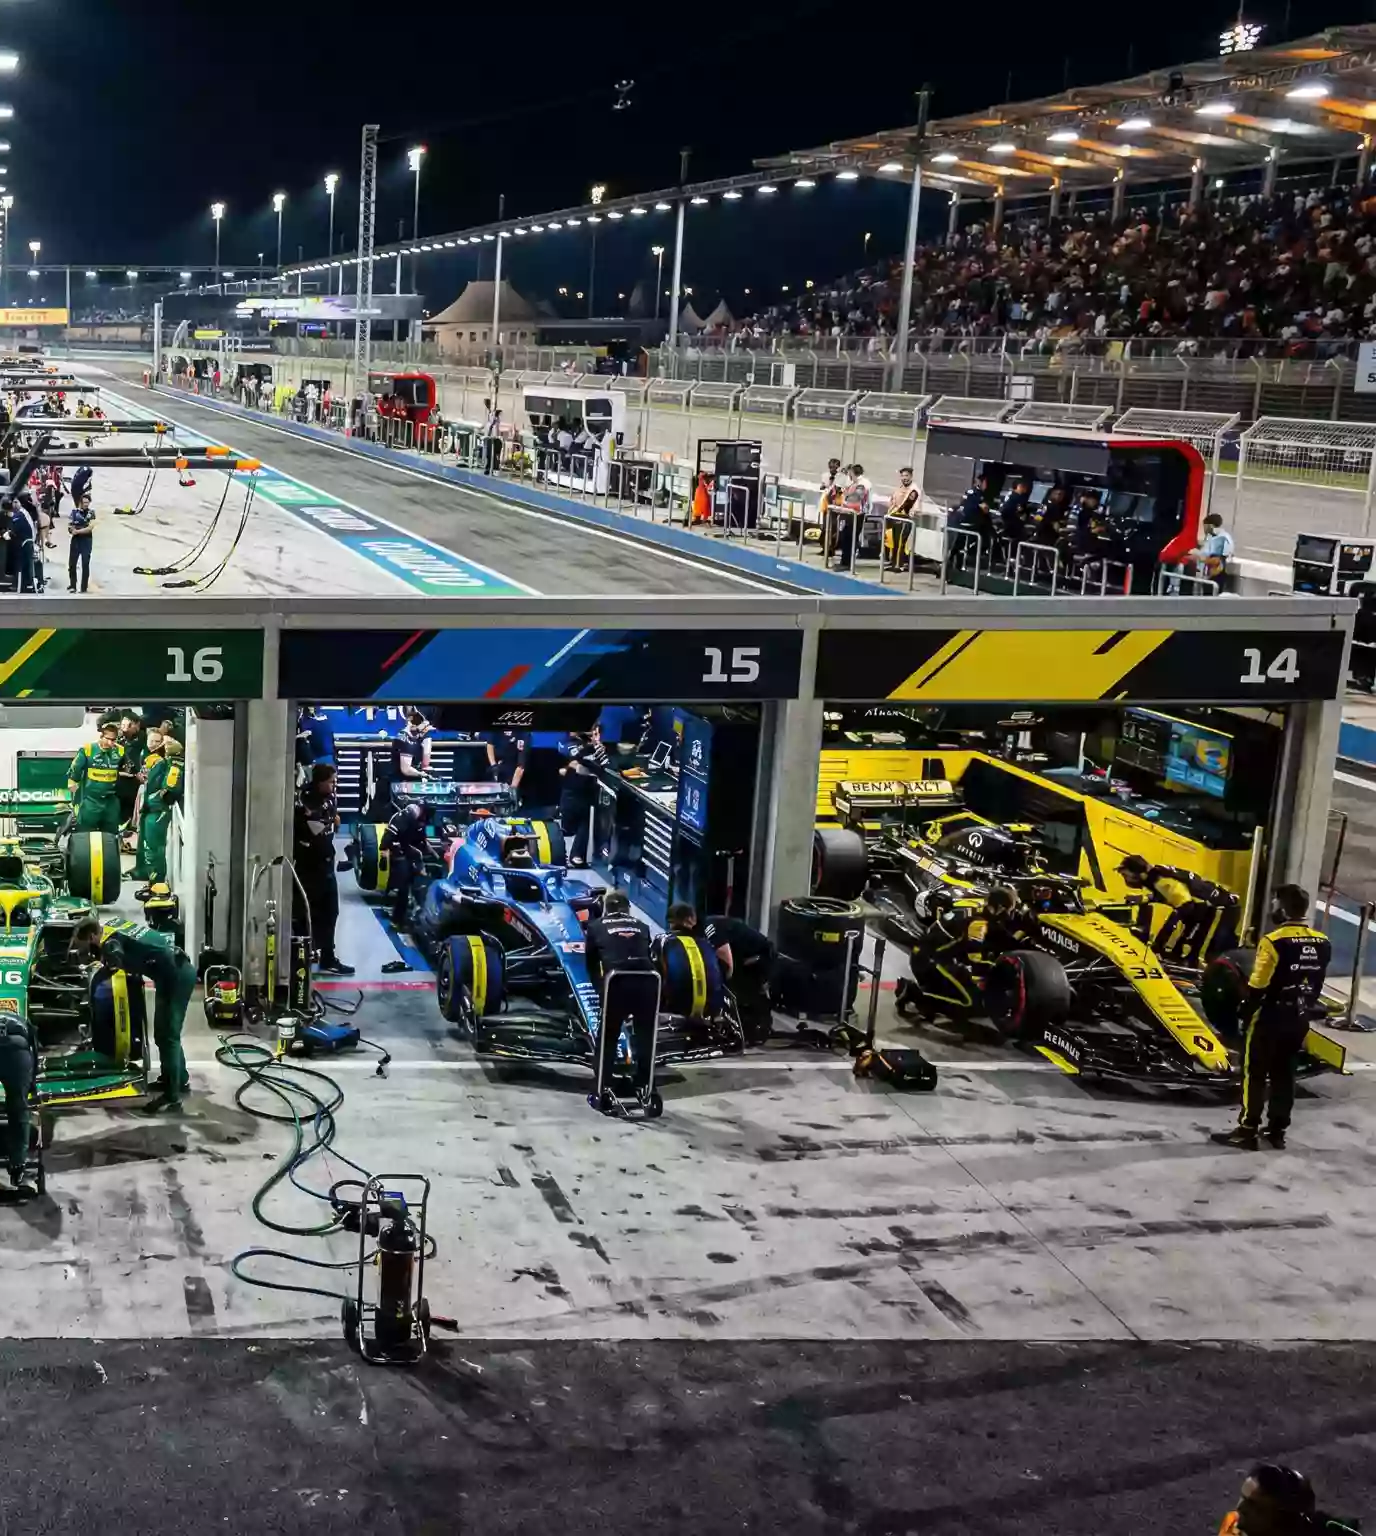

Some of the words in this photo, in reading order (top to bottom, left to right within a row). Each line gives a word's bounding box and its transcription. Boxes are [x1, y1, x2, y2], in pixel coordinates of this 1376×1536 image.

[167, 647, 223, 682] 16
[703, 647, 761, 682] 15
[1240, 648, 1300, 683] 14
